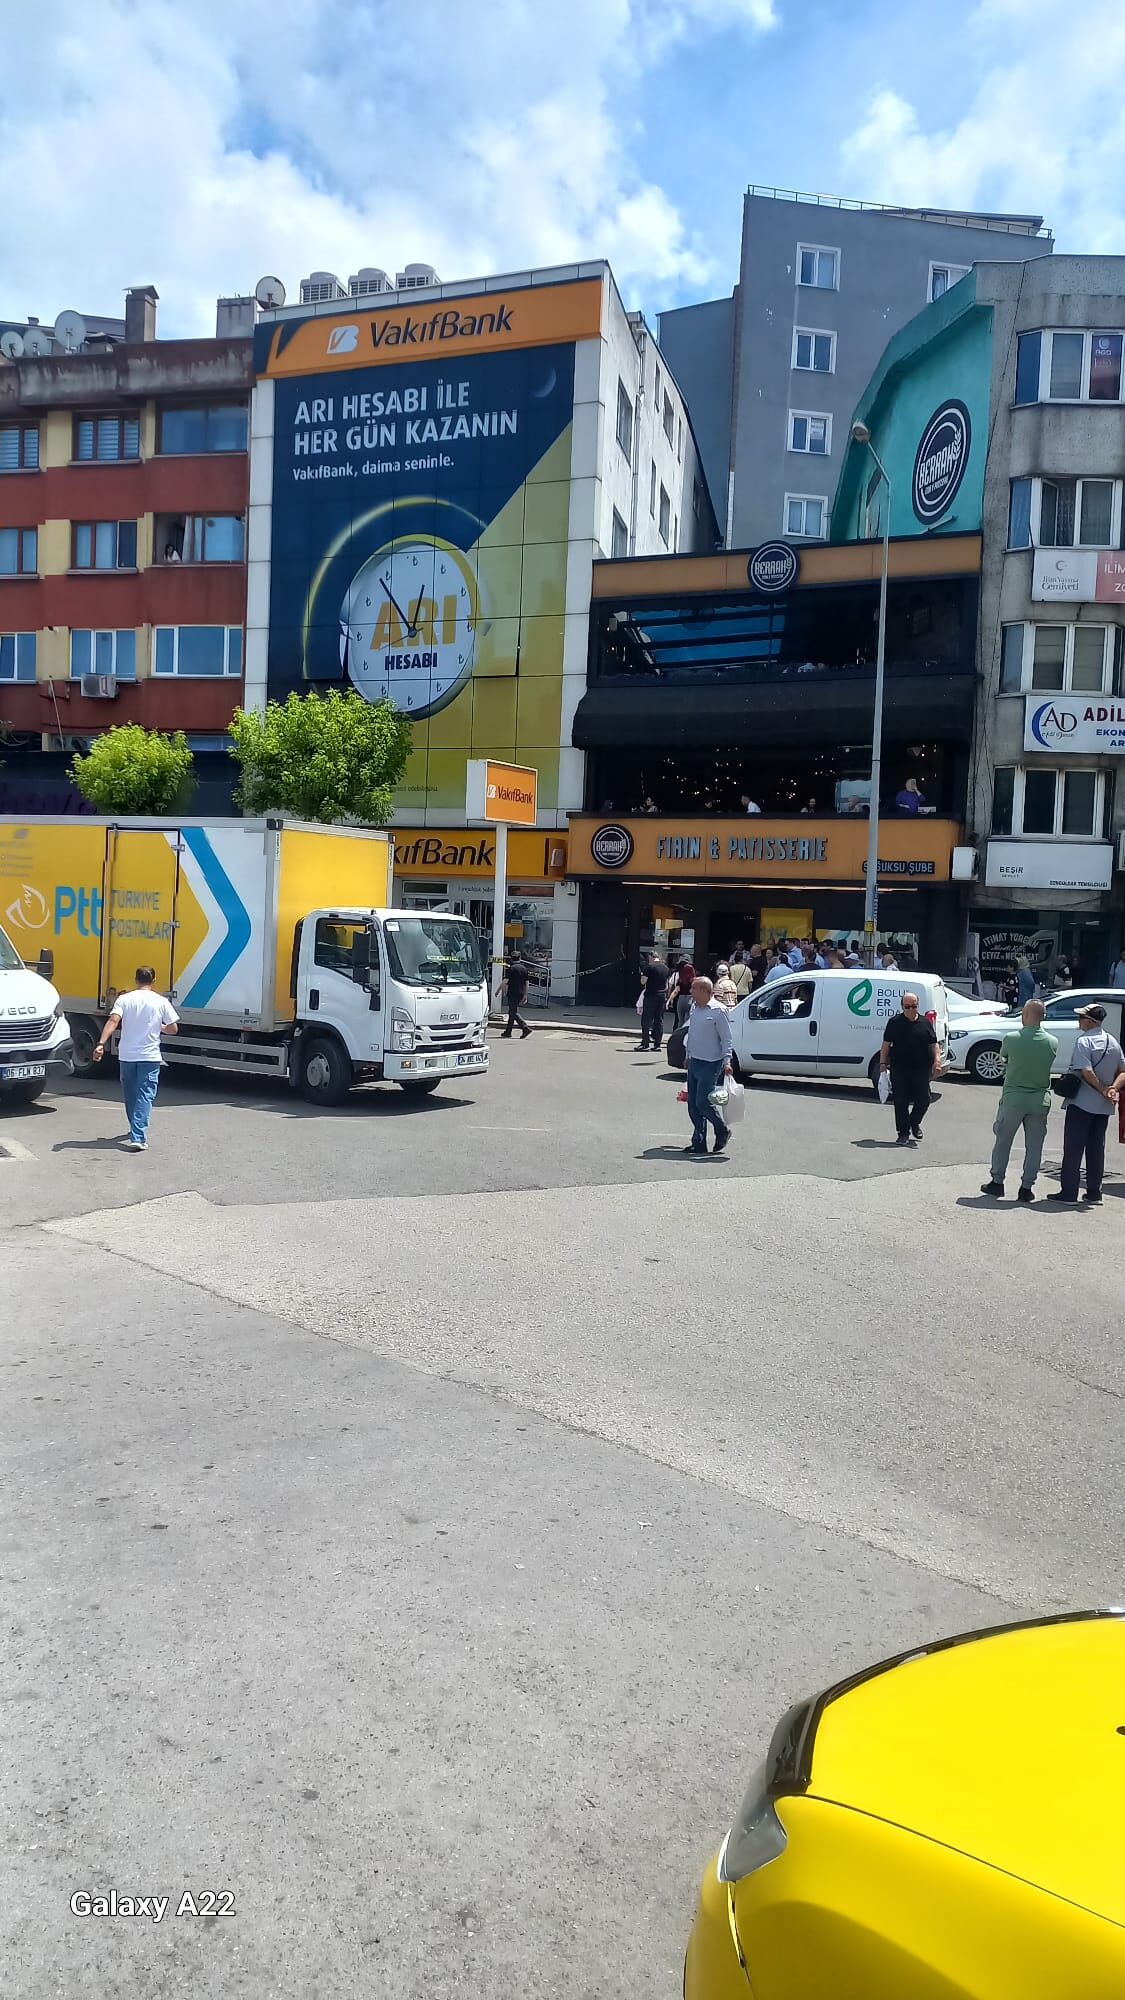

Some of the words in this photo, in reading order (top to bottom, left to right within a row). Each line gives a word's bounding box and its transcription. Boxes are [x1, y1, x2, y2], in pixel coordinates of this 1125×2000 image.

[371, 305, 514, 348] VakıfBank
[294, 398, 333, 425] ARI
[343, 386, 427, 420] HESABI
[437, 378, 470, 410] İLE
[294, 429, 338, 456] HER
[346, 415, 396, 450] GÜN
[406, 409, 518, 445] KAZANIN
[362, 459, 400, 475] daima
[404, 454, 455, 470] seninle.
[1041, 582, 1079, 593] Cemiyeti
[370, 595, 457, 651] ARI
[384, 652, 438, 671] HESABI
[498, 785, 533, 805] VakıfBank
[909, 862, 933, 874] ŞUBE
[54, 886, 103, 937] Ptt
[876, 998, 891, 1007] ER
